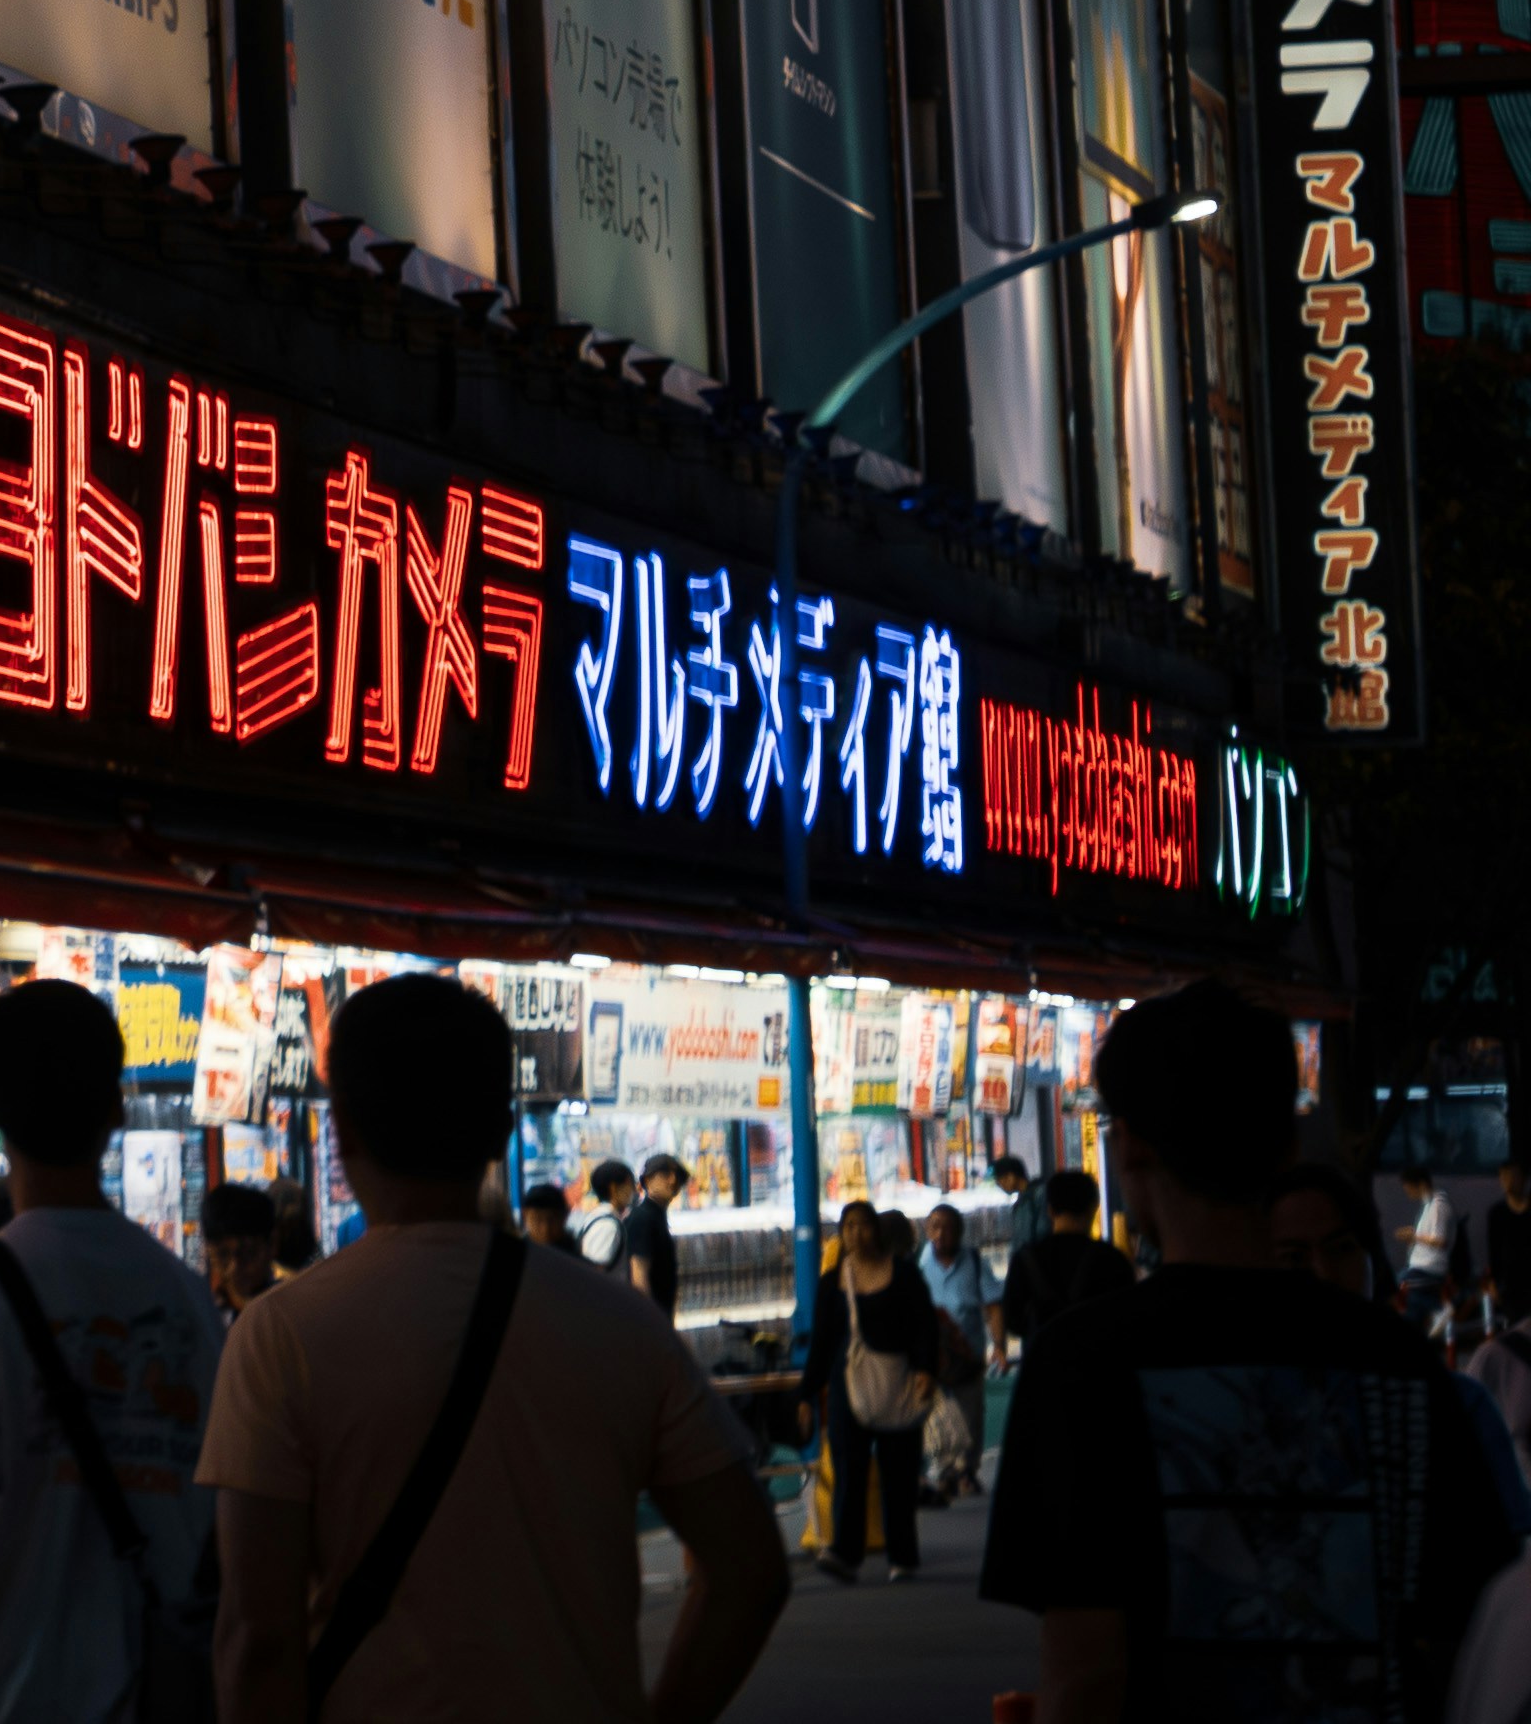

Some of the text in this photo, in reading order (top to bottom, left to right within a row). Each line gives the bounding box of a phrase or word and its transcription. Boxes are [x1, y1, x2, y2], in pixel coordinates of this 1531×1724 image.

[1295, 150, 1390, 731] マルチメディア北館
[567, 530, 965, 874] マルチメディア館
